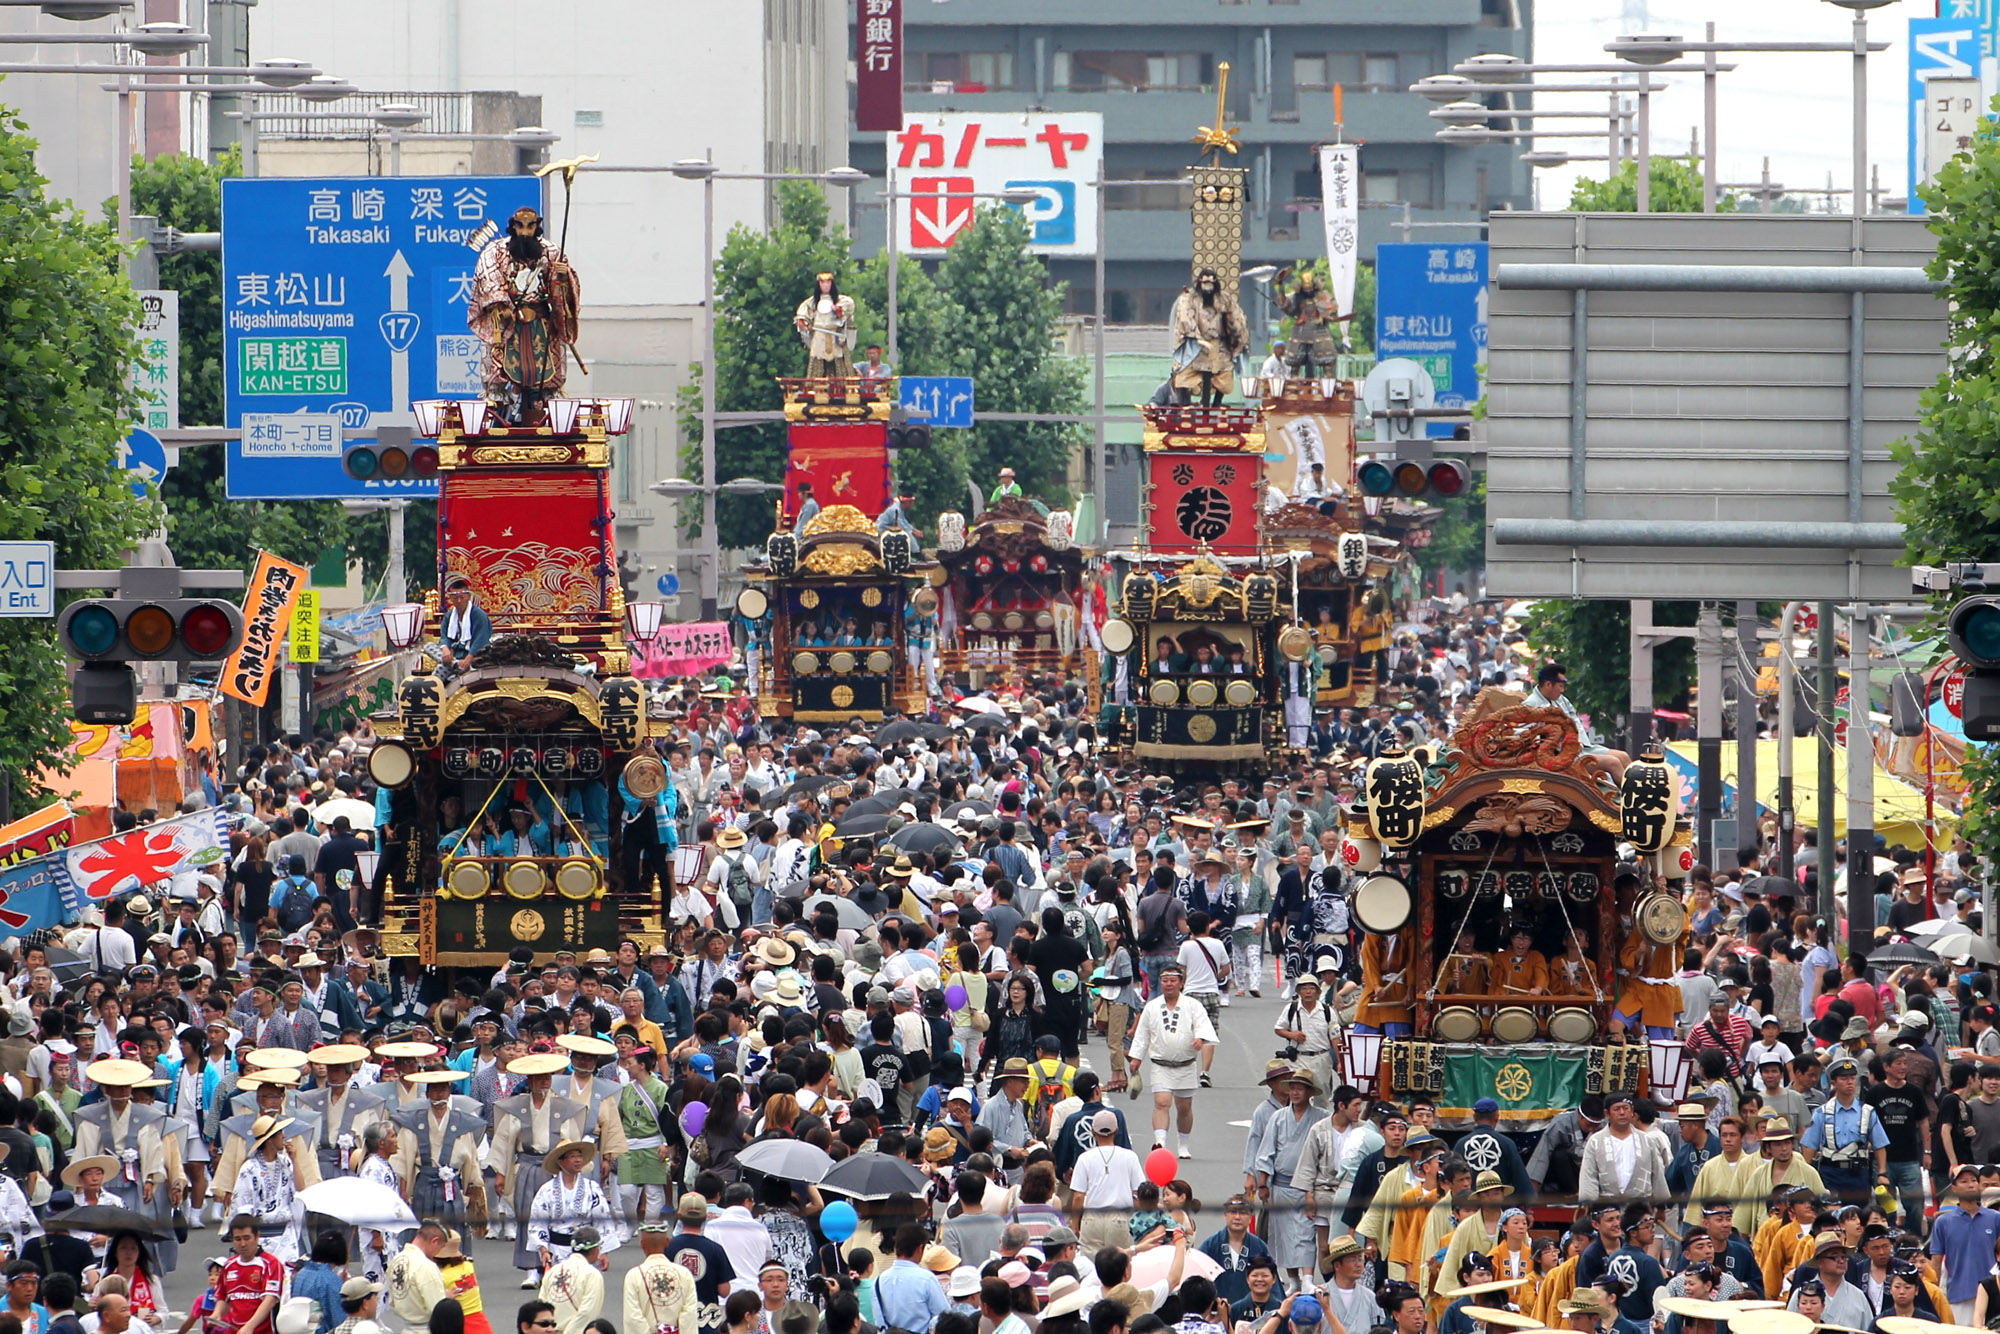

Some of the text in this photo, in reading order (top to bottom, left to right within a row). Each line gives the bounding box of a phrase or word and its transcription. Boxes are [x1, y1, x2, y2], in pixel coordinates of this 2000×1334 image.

[897, 124, 1089, 168] カノーヤ
[309, 187, 487, 222] 高崎 深谷
[306, 225, 477, 246] Takasaki Fukay
[1428, 248, 1476, 269] 高崎
[1426, 271, 1479, 283] Takasaki
[236, 272, 345, 307] 東松山
[229, 310, 354, 331] Higashimatsuyama
[387, 318, 411, 340] 17
[1384, 315, 1452, 336] 東松山
[245, 340, 341, 371] 関越道
[147, 338, 168, 429] 森林公園
[245, 374, 341, 391] KAN-ETSU
[250, 424, 332, 441] 本町一丁目
[249, 442, 333, 452] Honcho 1-chome
[1, 561, 45, 588] 入口
[9, 592, 40, 607] Ent.
[296, 593, 313, 660] 追突注意
